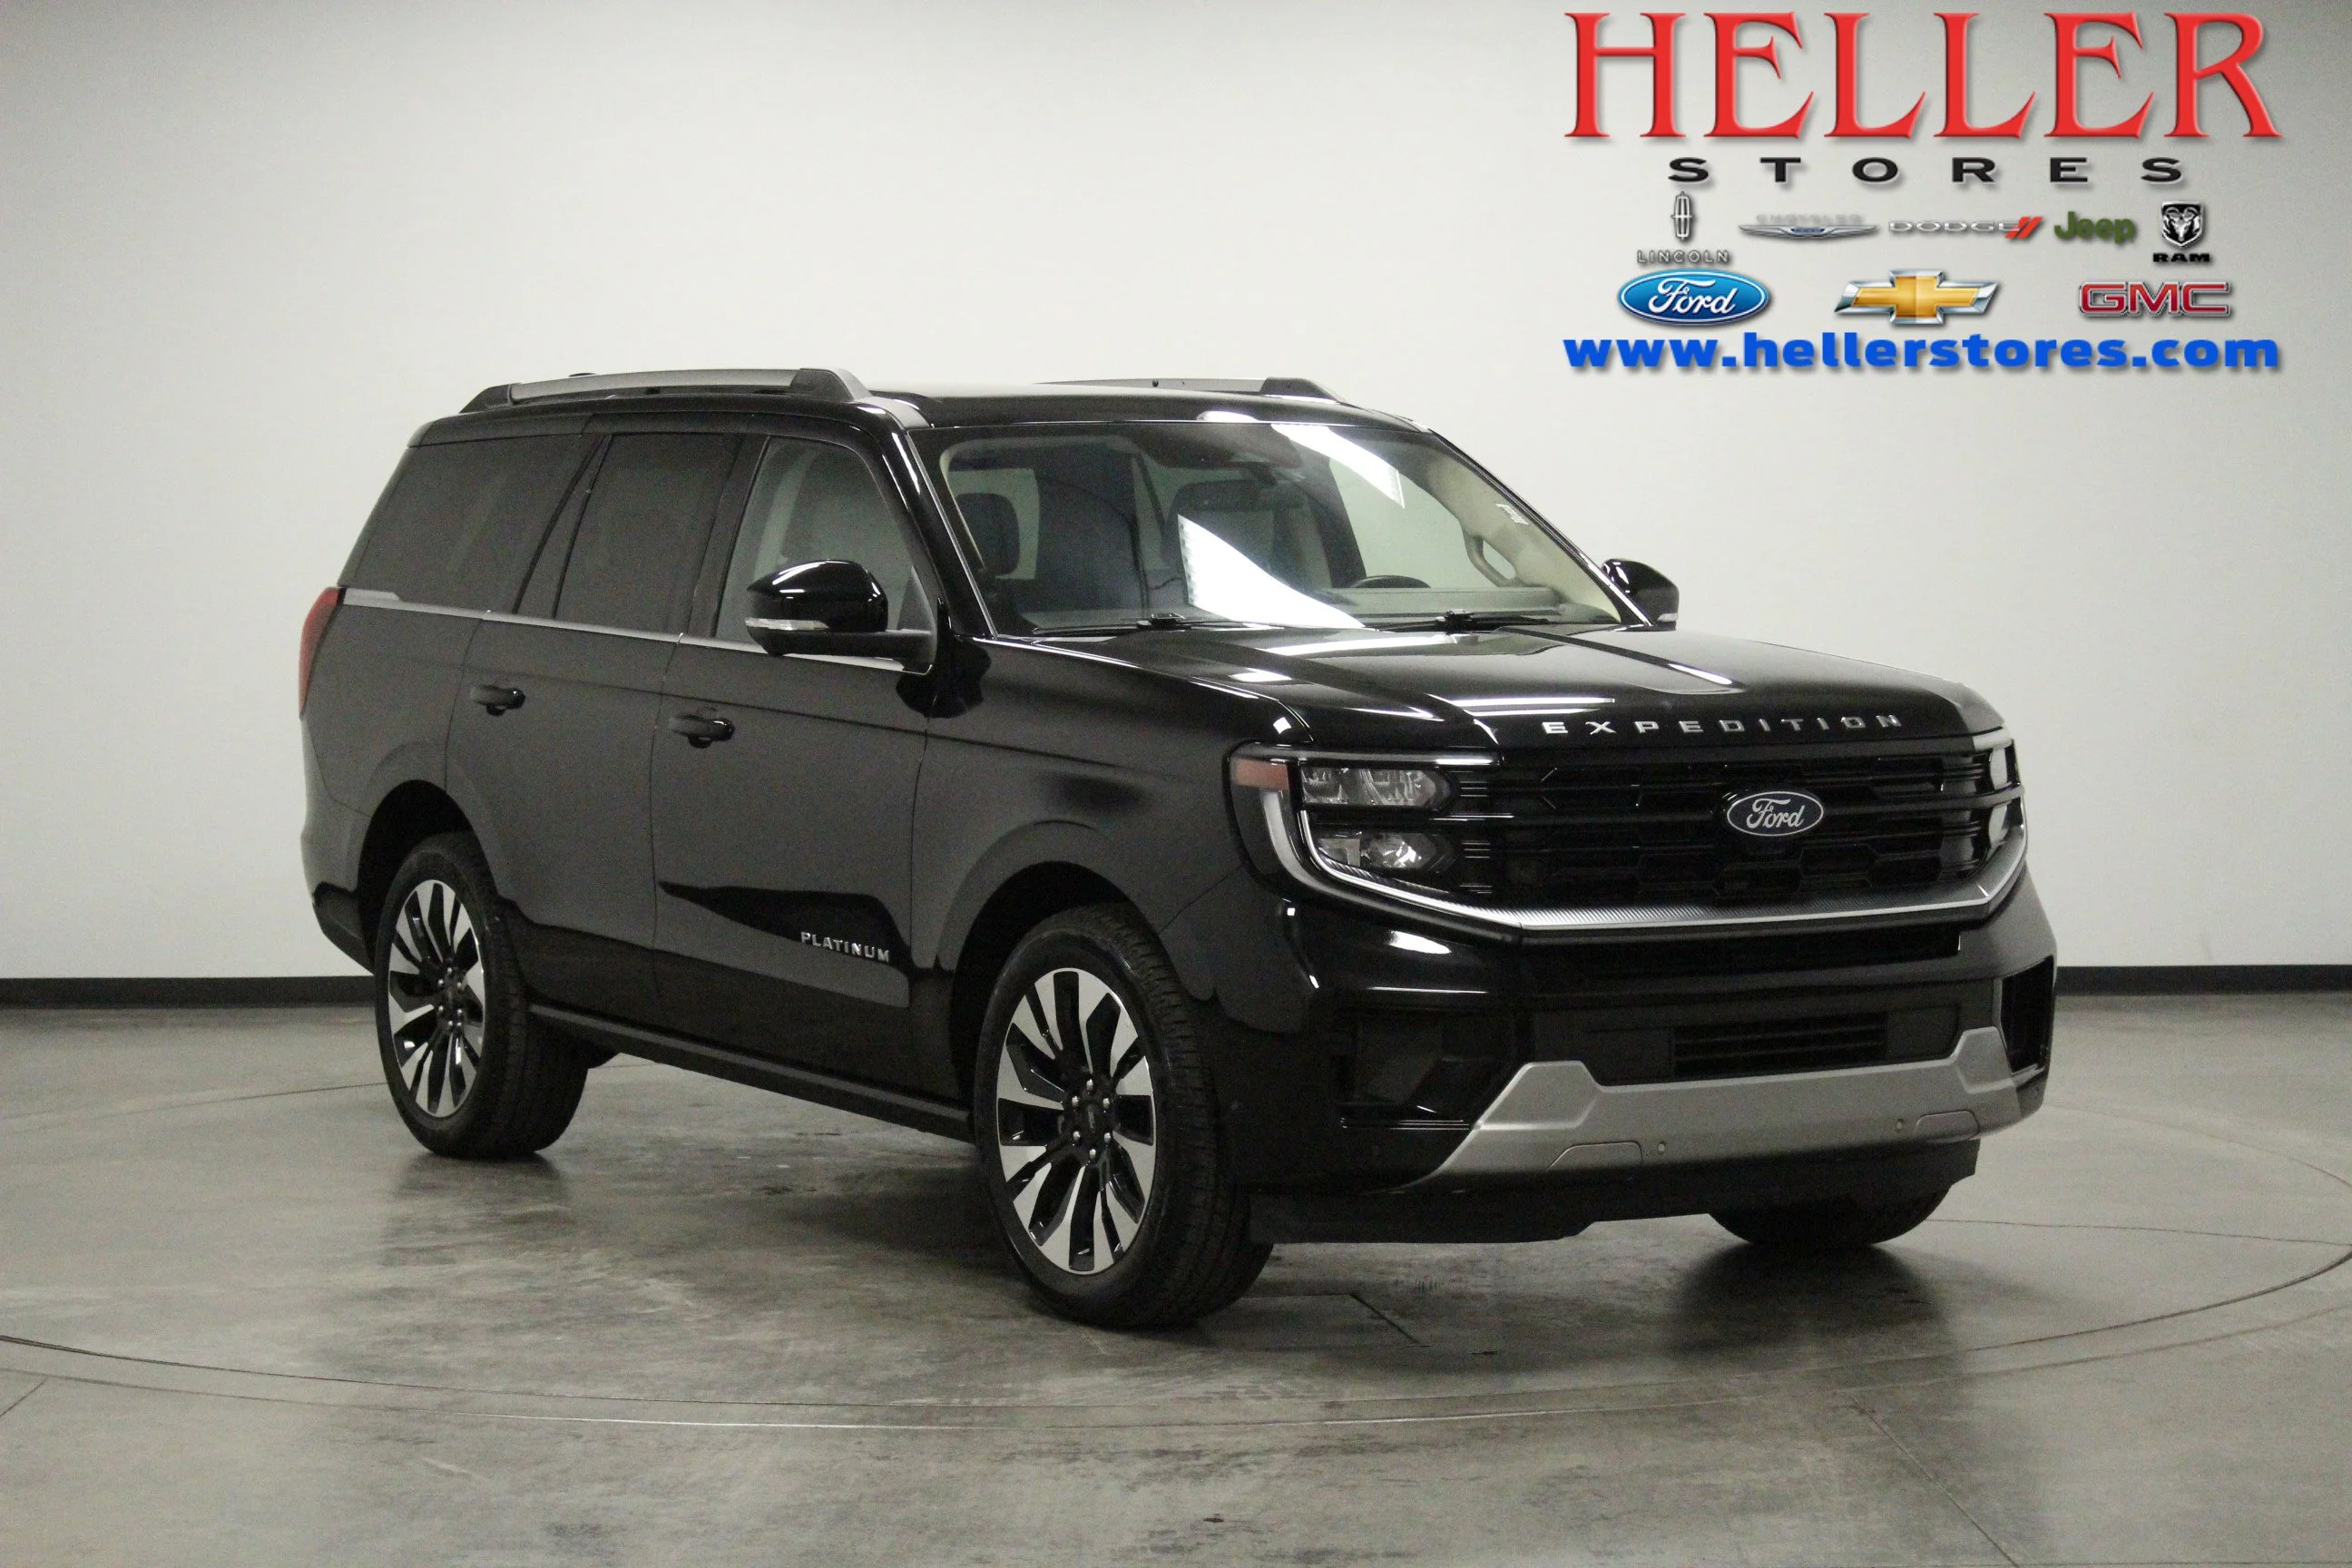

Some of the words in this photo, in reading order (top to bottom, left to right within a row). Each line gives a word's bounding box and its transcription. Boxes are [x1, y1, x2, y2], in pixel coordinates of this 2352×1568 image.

[1542, 715, 1901, 735] EXPEDITION
[1746, 796, 1805, 829] Ford
[800, 931, 890, 963] PLATINUM
